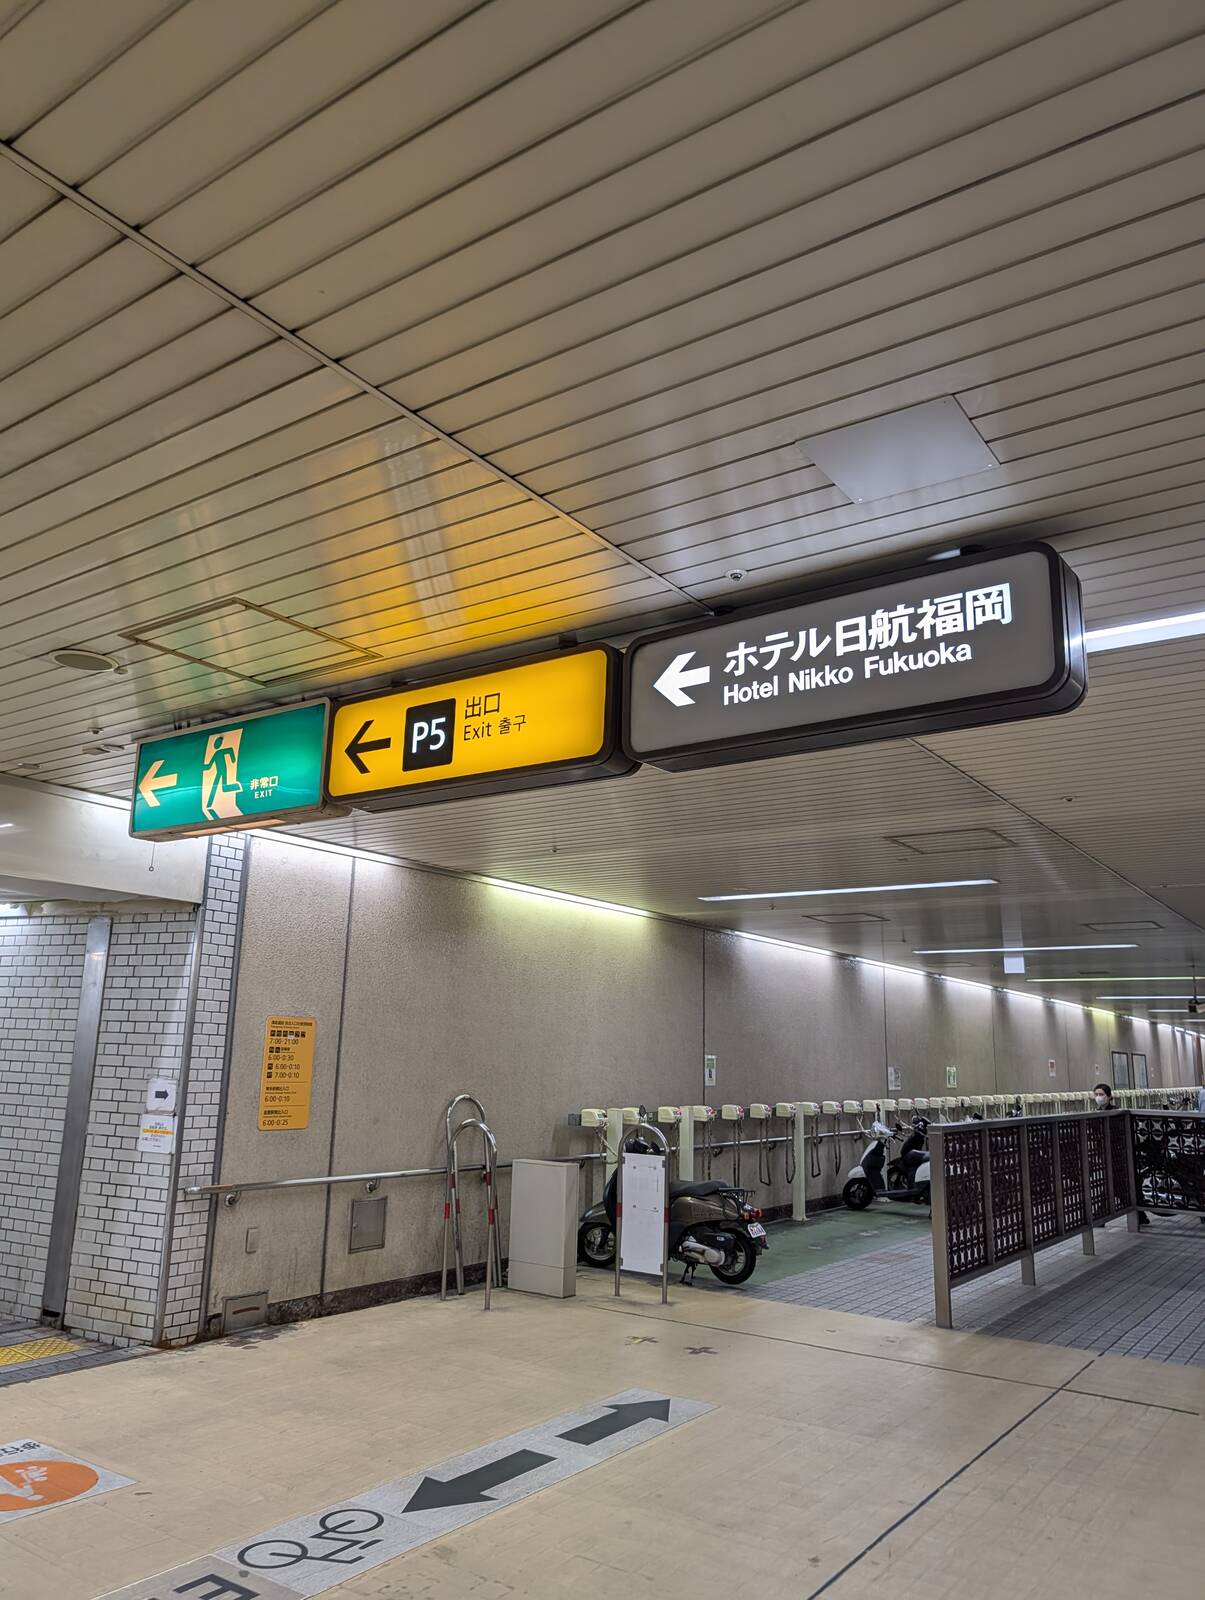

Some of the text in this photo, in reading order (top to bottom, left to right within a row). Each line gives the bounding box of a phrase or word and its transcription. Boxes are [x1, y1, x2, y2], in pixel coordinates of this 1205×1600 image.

[723, 582, 1012, 677] ホテル日航福岡
[723, 641, 973, 706] Hotel Nikko Fukuoka
[464, 692, 501, 720] 出口
[411, 716, 446, 754] P5
[463, 714, 527, 741] Exit 출구
[249, 775, 279, 791] 非常口
[254, 789, 273, 799] EXIT
